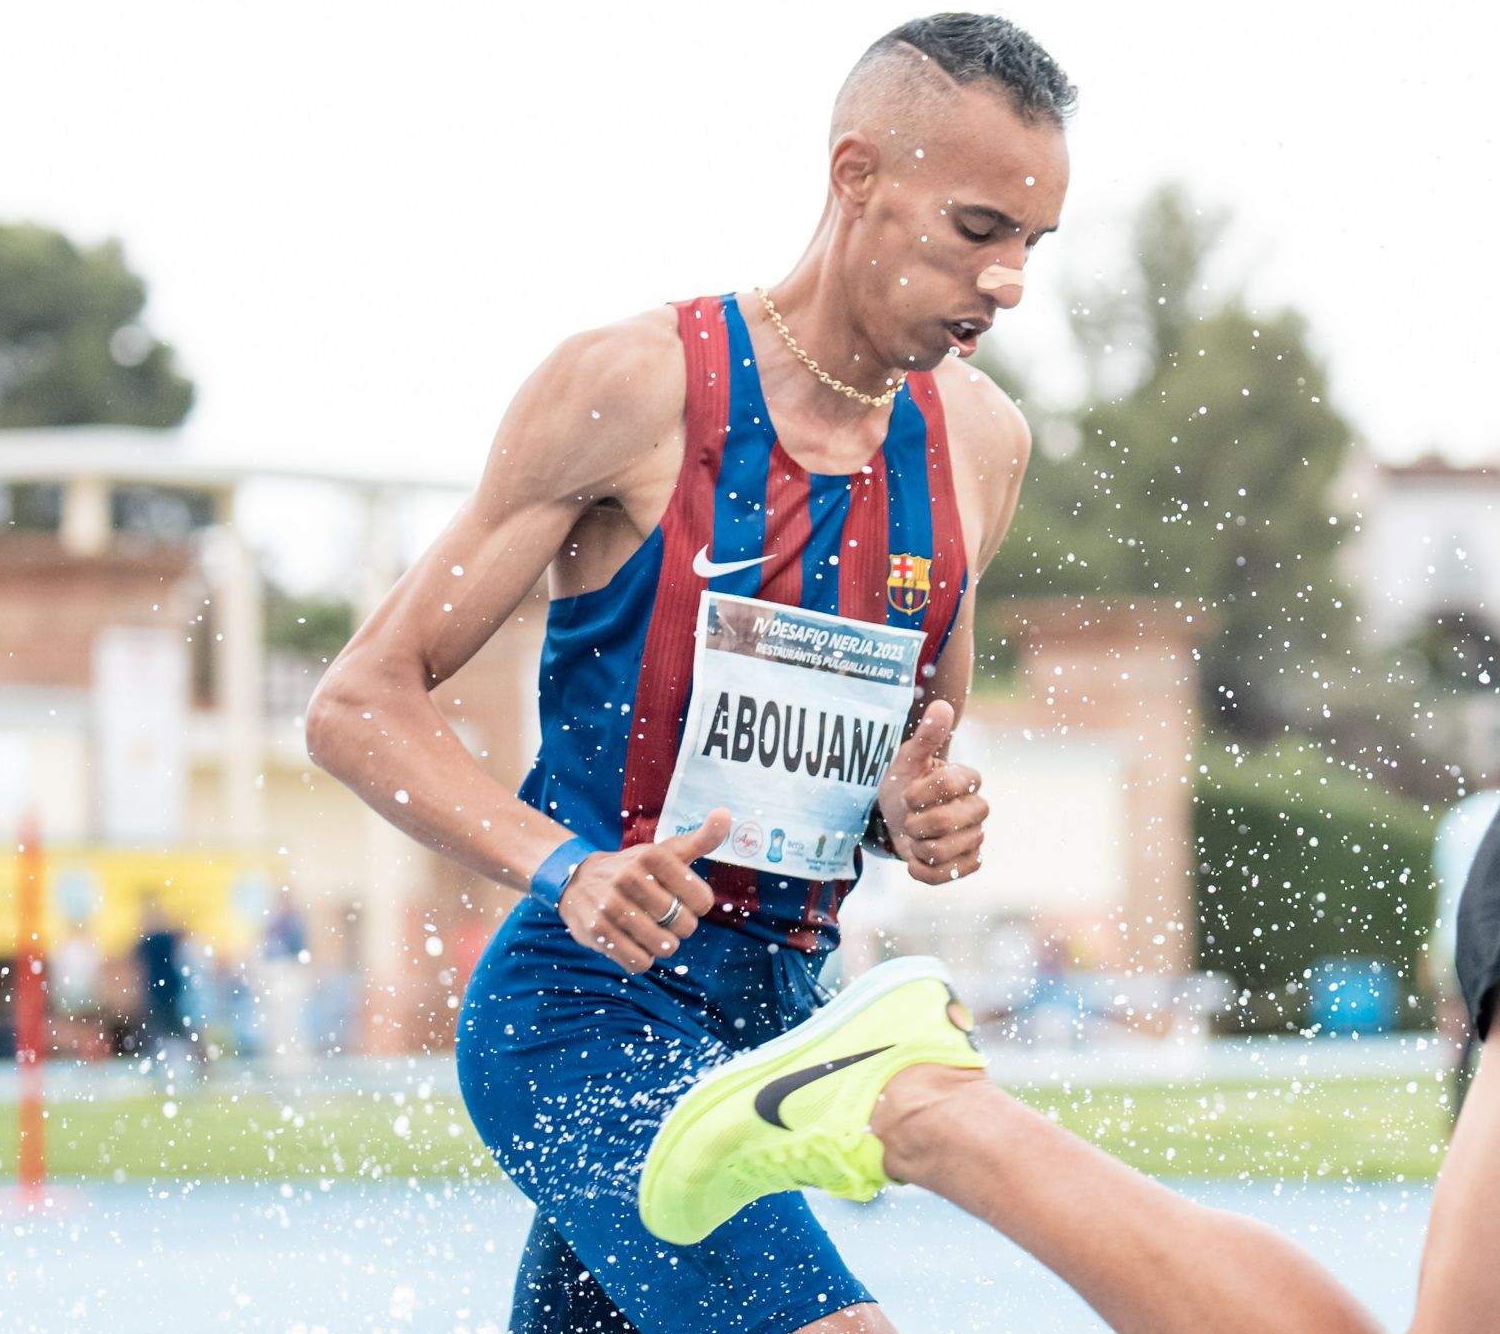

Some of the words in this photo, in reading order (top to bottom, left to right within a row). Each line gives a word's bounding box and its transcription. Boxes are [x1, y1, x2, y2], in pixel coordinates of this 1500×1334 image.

[752, 617, 769, 636] IV
[828, 633, 875, 655] NERJA
[873, 642, 905, 662] 2023
[755, 642, 823, 666] RESTAURANTES
